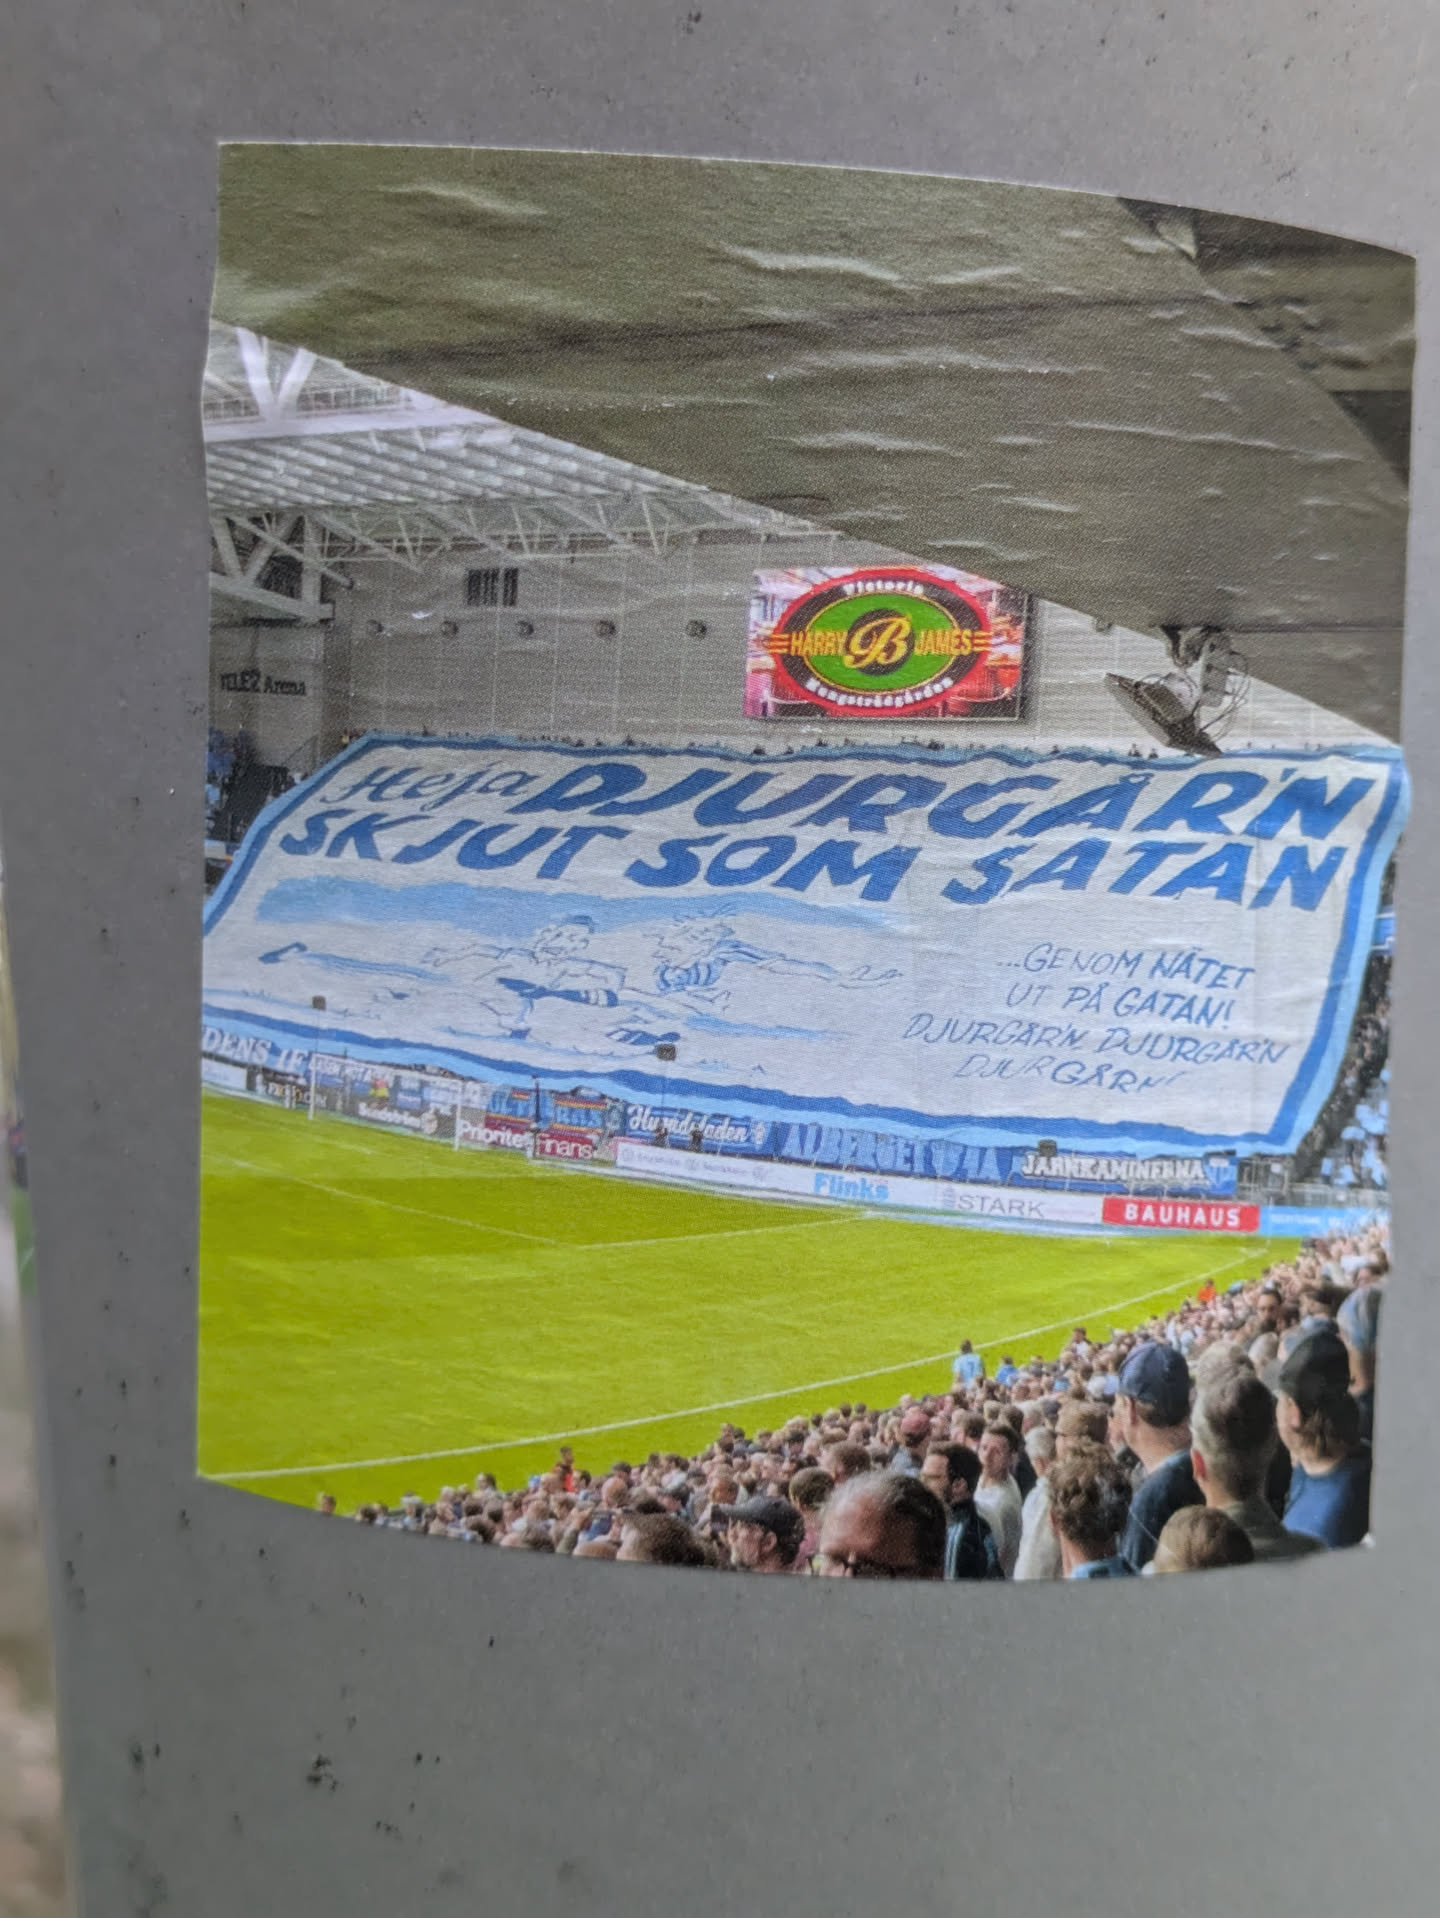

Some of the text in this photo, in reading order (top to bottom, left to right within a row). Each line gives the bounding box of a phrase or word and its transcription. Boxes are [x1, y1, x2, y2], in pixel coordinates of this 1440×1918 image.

[790, 614, 973, 668] HARRY B JAMES
[321, 761, 540, 811] Heja
[279, 809, 1349, 911] SKJUT SOM SATAN
[1006, 982, 1235, 1031] UT PÅ GATAN!
[814, 1172, 889, 1200] Flinks
[957, 1194, 1045, 1218] STARK
[1124, 1203, 1241, 1227] BAUHAUS
